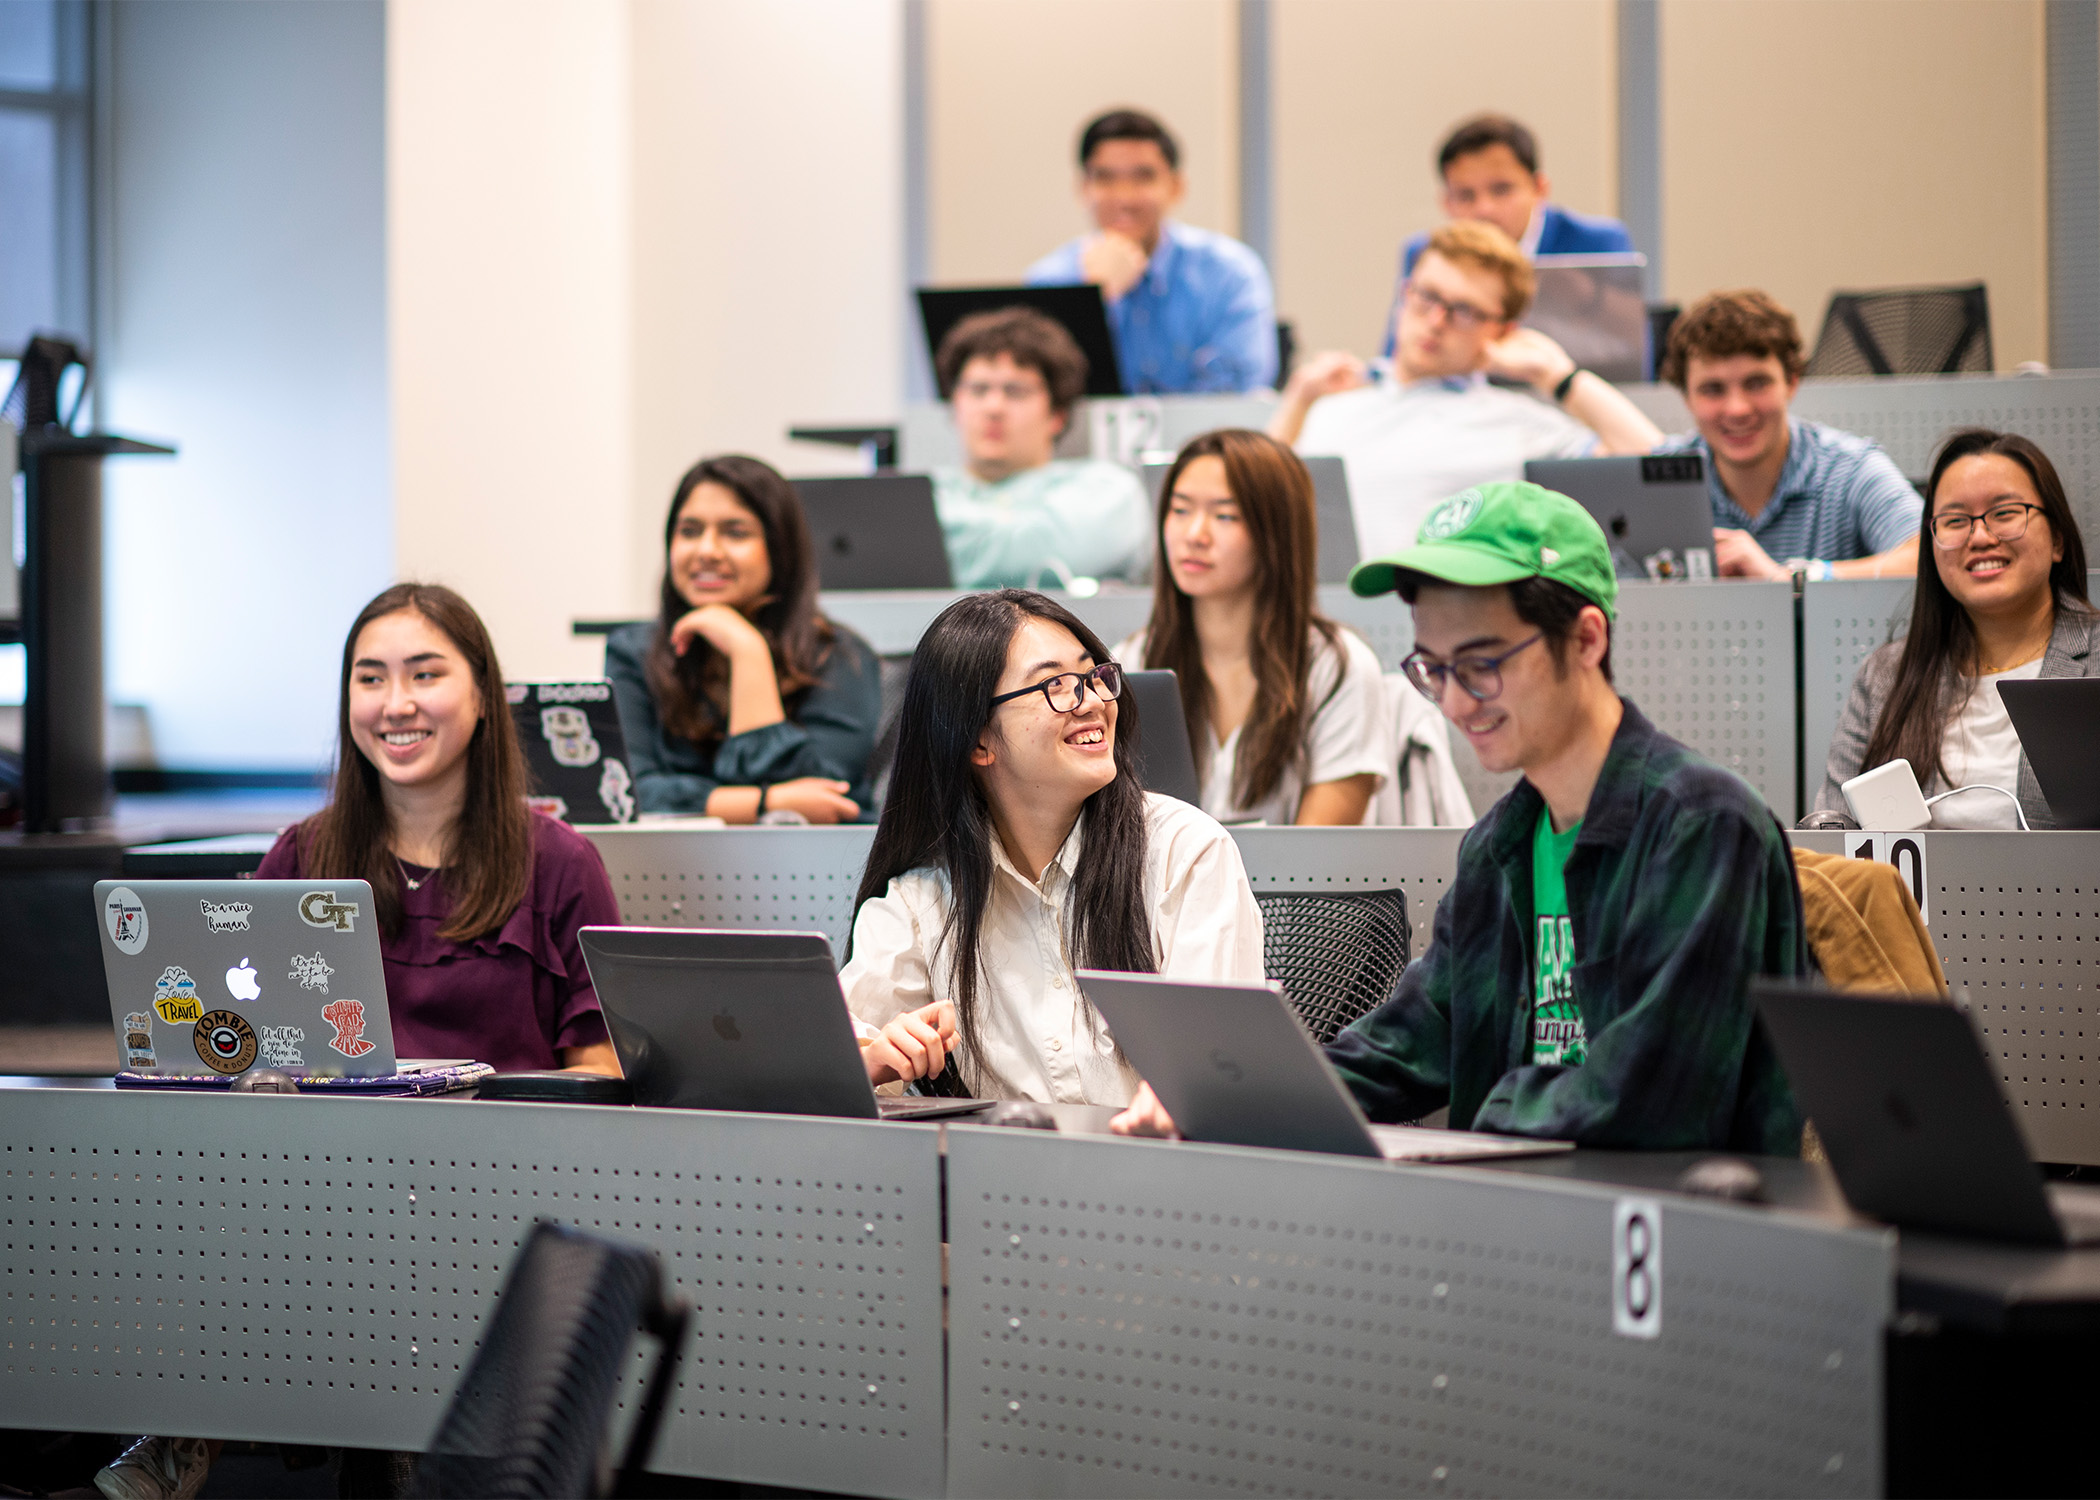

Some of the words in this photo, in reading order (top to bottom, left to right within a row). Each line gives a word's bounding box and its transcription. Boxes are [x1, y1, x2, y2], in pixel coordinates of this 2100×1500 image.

[1105, 411, 1158, 458] 12
[1855, 838, 1923, 914] 0
[201, 900, 218, 913] Be
[219, 904, 228, 913] a
[228, 904, 252, 913] nice
[300, 893, 358, 930] GT
[208, 916, 249, 931] human
[156, 985, 194, 1005] Love
[158, 1001, 199, 1020] TRAVEL
[195, 1012, 254, 1041] ZOMBIE
[200, 1042, 221, 1067] COFFEE
[231, 1043, 253, 1069] DONUTS
[1626, 1213, 1650, 1321] 8
